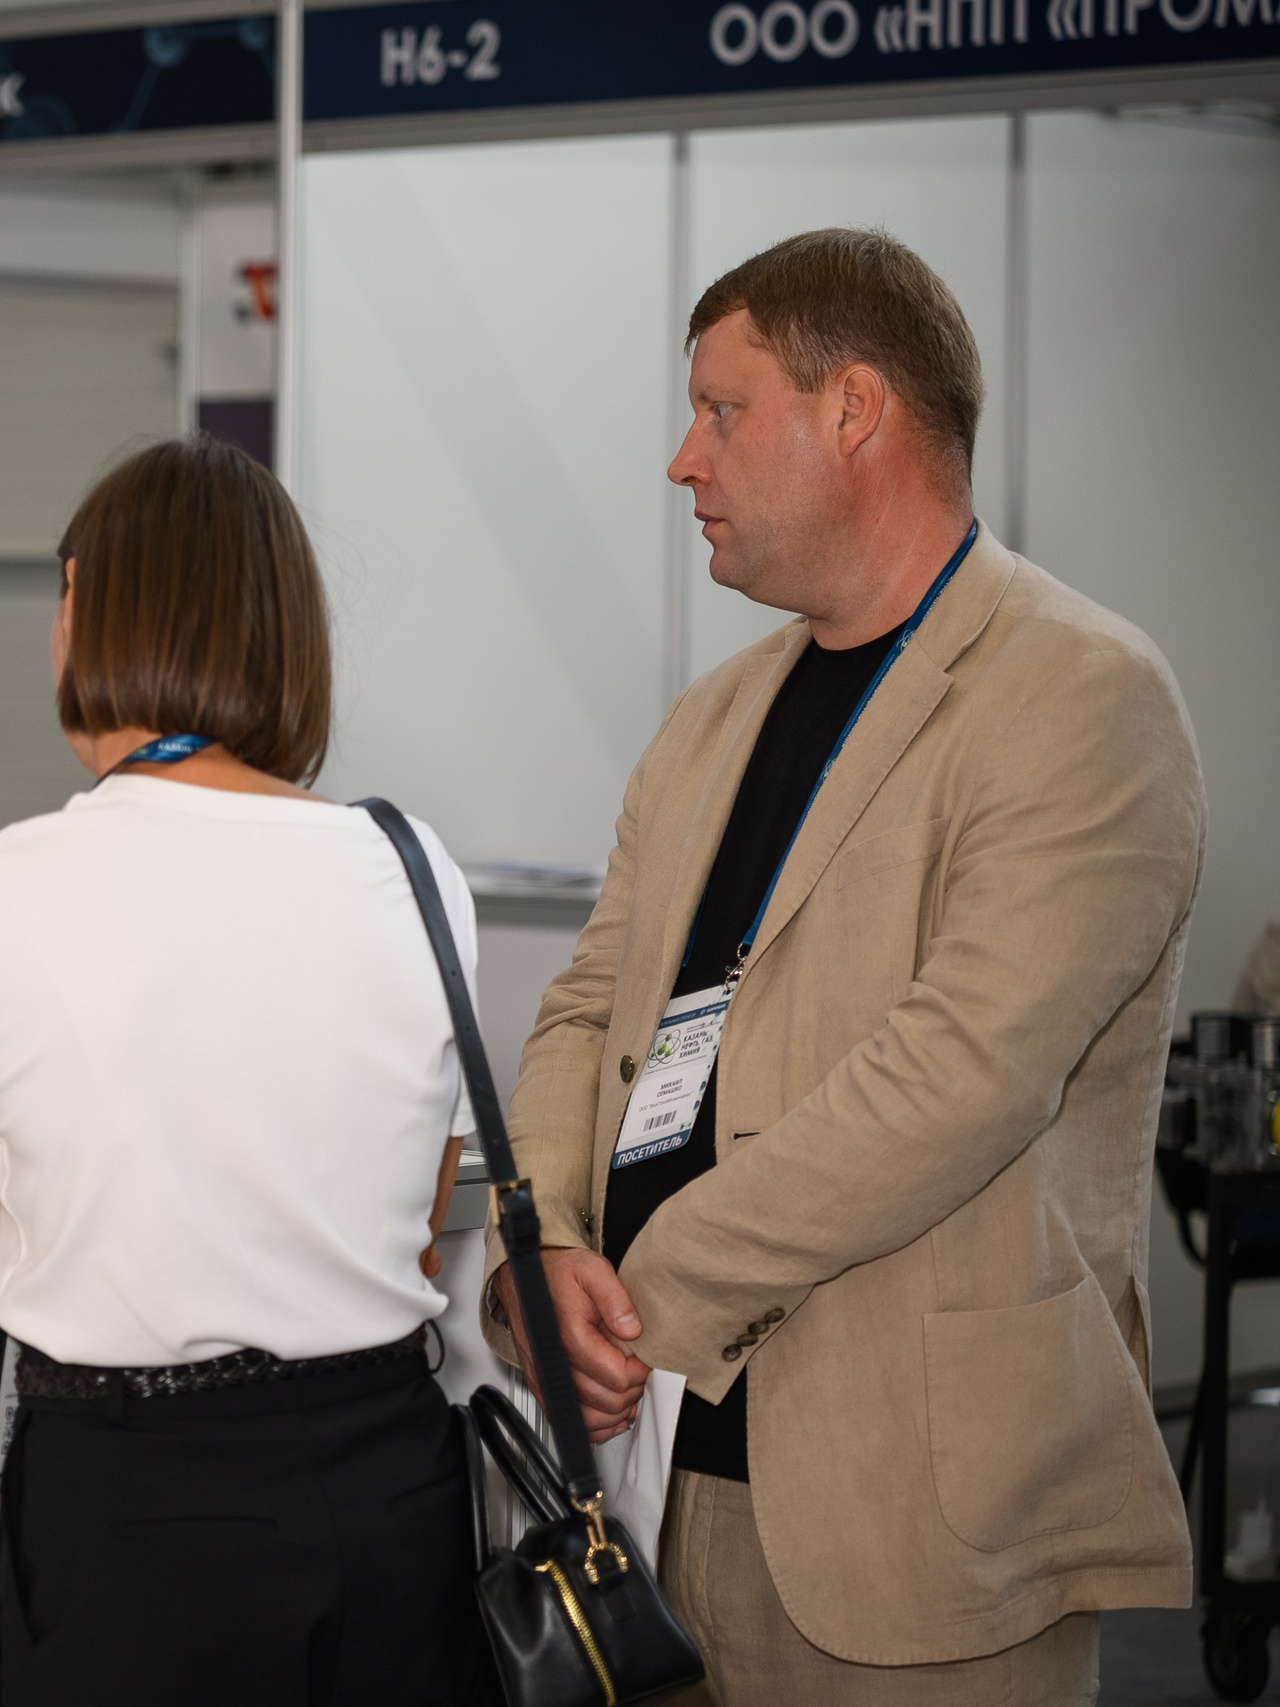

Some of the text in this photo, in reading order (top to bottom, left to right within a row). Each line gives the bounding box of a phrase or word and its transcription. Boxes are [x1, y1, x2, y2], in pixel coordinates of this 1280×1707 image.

[380, 19, 501, 87] Н6-2
[710, 0, 860, 65] ООО
[1046, 0, 1280, 41] «ПРОМ
[617, 1134, 683, 1166] ПОСЕТИТЕЛЬ
